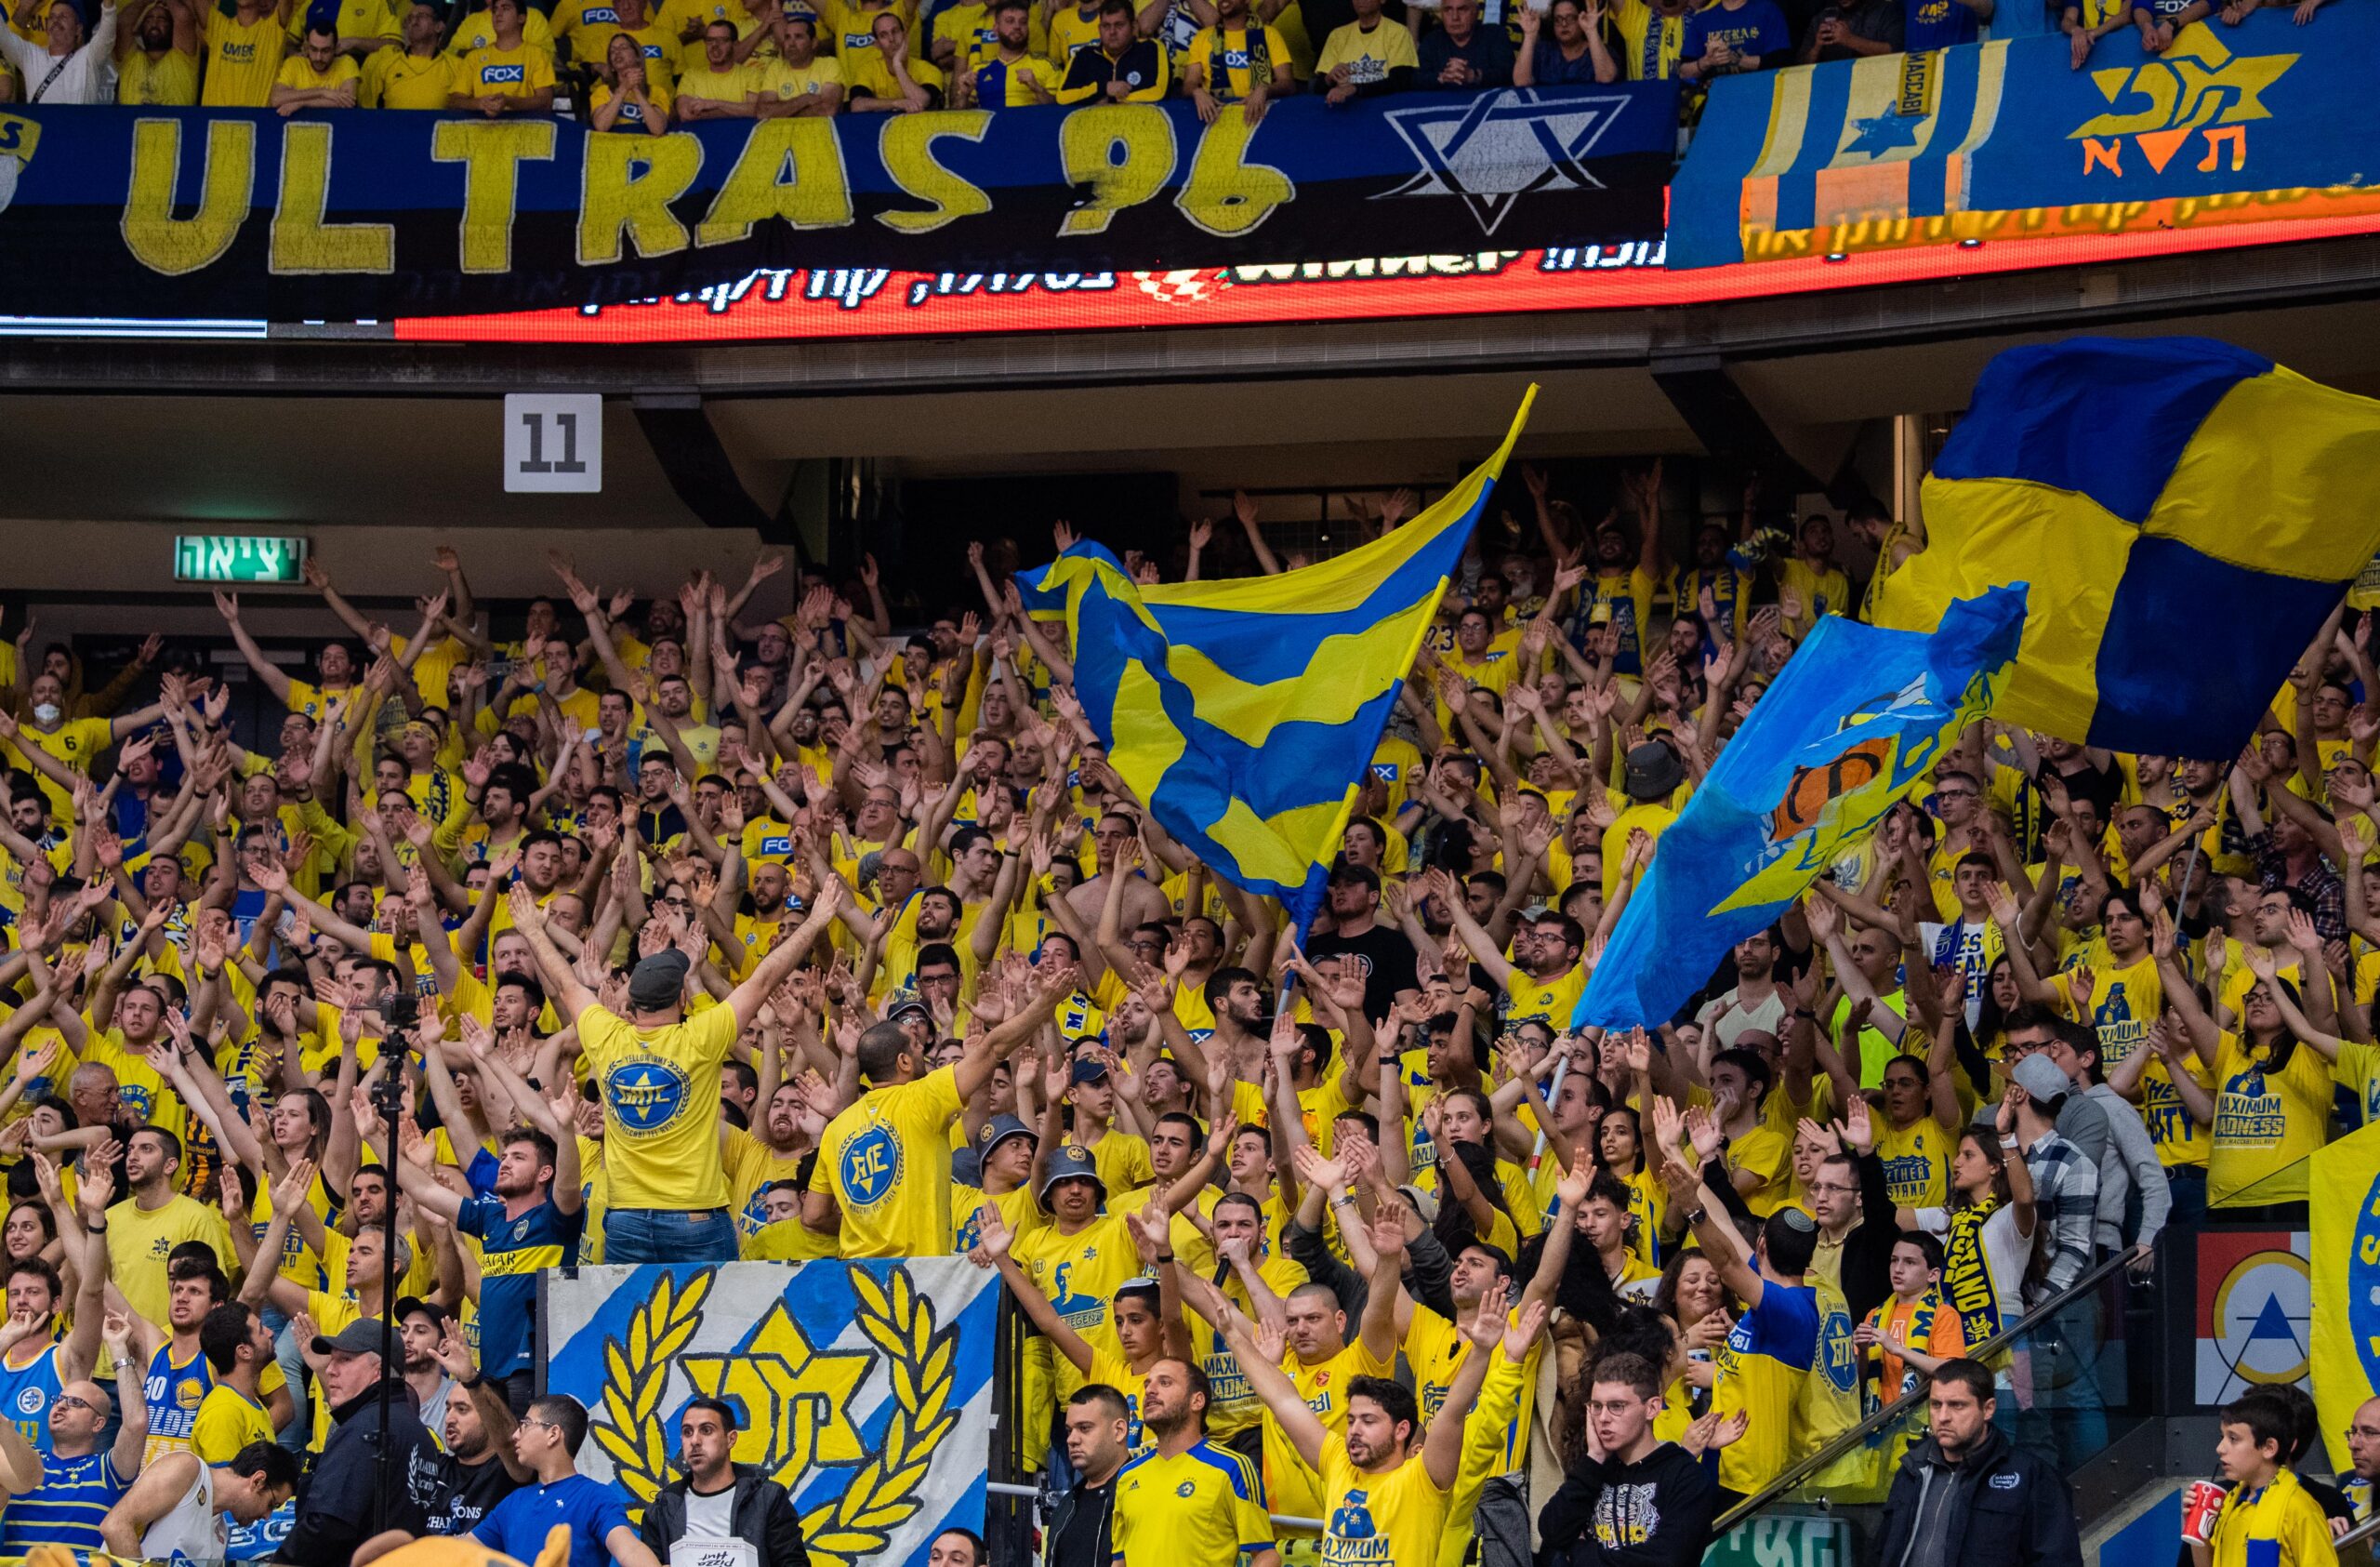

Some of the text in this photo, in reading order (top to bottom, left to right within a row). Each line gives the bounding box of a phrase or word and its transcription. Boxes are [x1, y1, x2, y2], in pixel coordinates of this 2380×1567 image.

[585, 9, 620, 22] FOX
[1225, 53, 1250, 66] OX
[483, 67, 522, 83] FOX
[1901, 53, 1925, 115] MACCABI
[119, 100, 1296, 276] ULTRAS 96
[519, 412, 588, 474] 11
[181, 536, 298, 581] יציאה
[1426, 625, 1456, 652] 23
[64, 736, 77, 751] 6
[764, 839, 792, 853] FO
[2216, 1117, 2285, 1136] ADNESS
[1886, 1164, 1926, 1184] ETHER
[1887, 1182, 1926, 1199] STAND
[1204, 1355, 1239, 1376] MAXI
[143, 1375, 167, 1401] 30
[1324, 1537, 1390, 1560] AXIMUM
